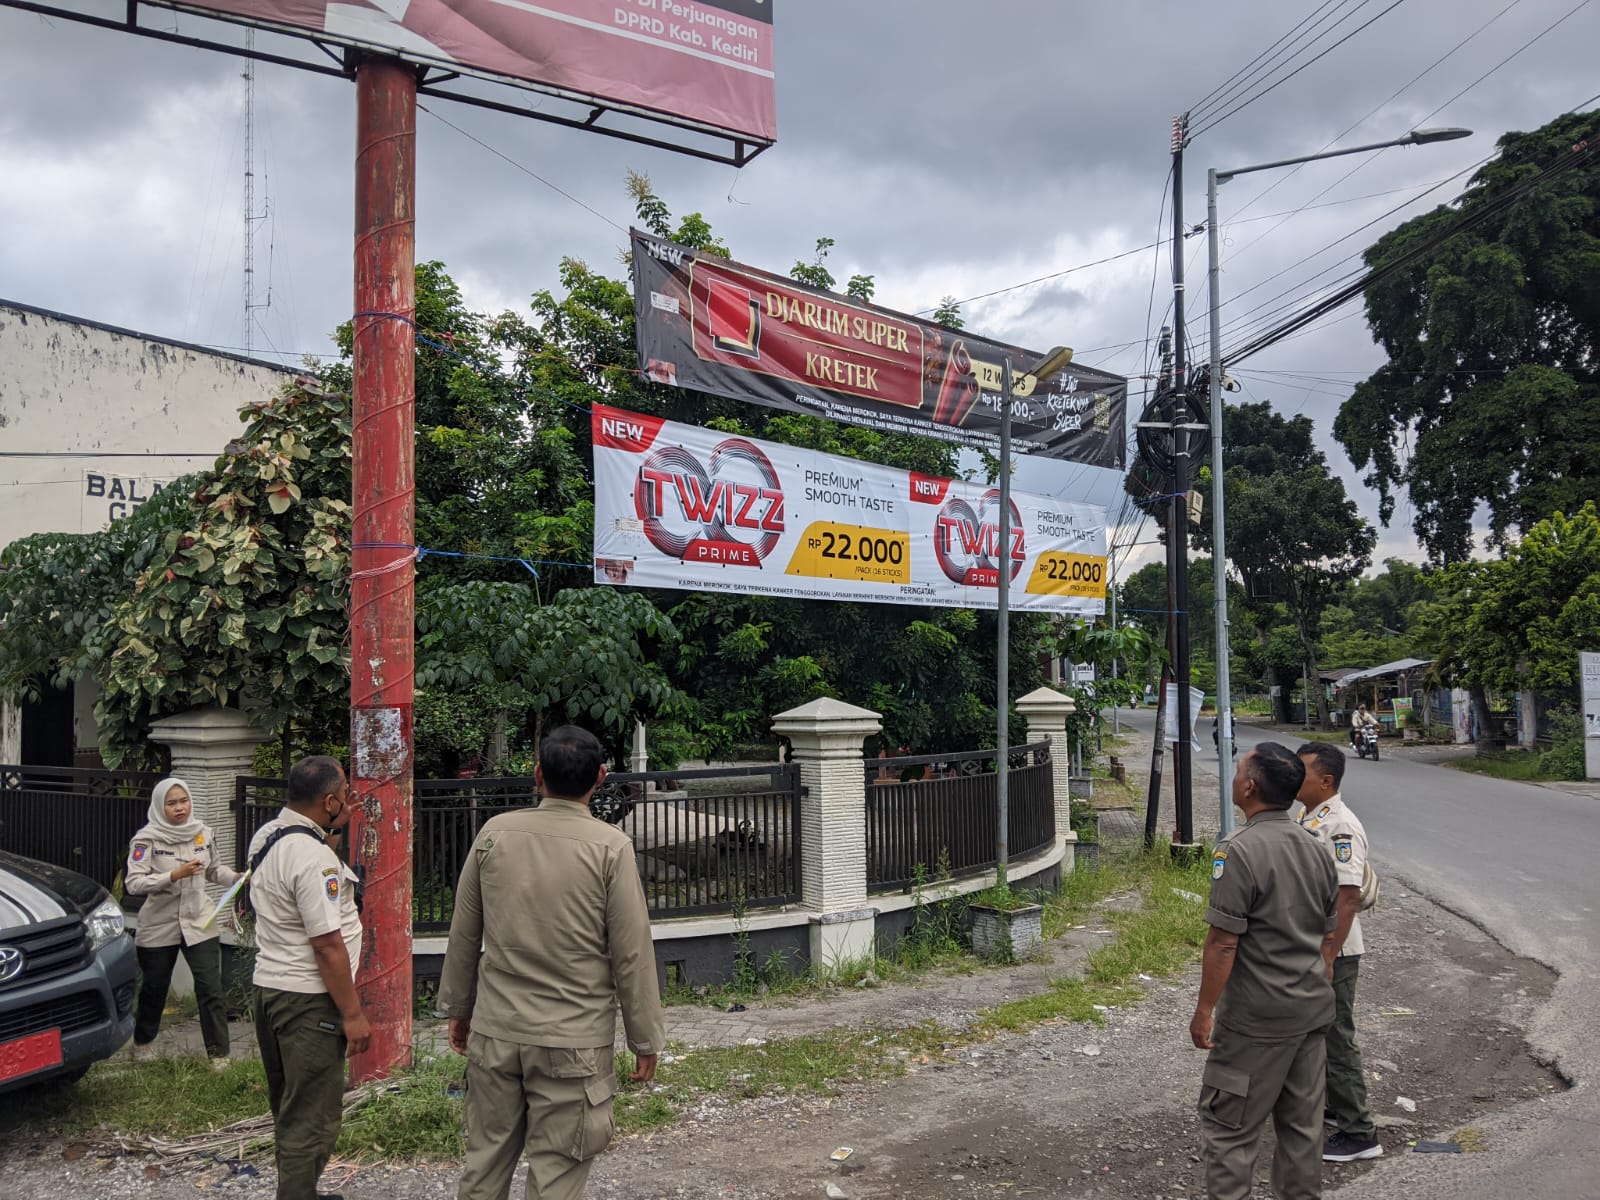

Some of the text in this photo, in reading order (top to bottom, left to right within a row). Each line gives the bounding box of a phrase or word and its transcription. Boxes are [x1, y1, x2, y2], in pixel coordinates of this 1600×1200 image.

[662, 0, 758, 39] Perjuangan
[614, 7, 758, 63] DPRD Kab. Kediri
[647, 241, 684, 266] NEW
[766, 291, 910, 354] DJARUM SUPER
[805, 351, 880, 392] KRETEK
[983, 368, 992, 382] 12
[602, 417, 644, 442] NEW
[804, 470, 860, 491] PREMIUM
[915, 480, 940, 496] NEW
[642, 466, 785, 535] TWIZZ
[804, 488, 894, 513] SMOOTH TASTE
[1037, 510, 1073, 526] PREMIUM
[1037, 524, 1096, 542] SMOOTH TASTE
[698, 546, 751, 562] PRIME
[971, 573, 997, 585] PRIM
[900, 586, 937, 596] PERINGATAN:
